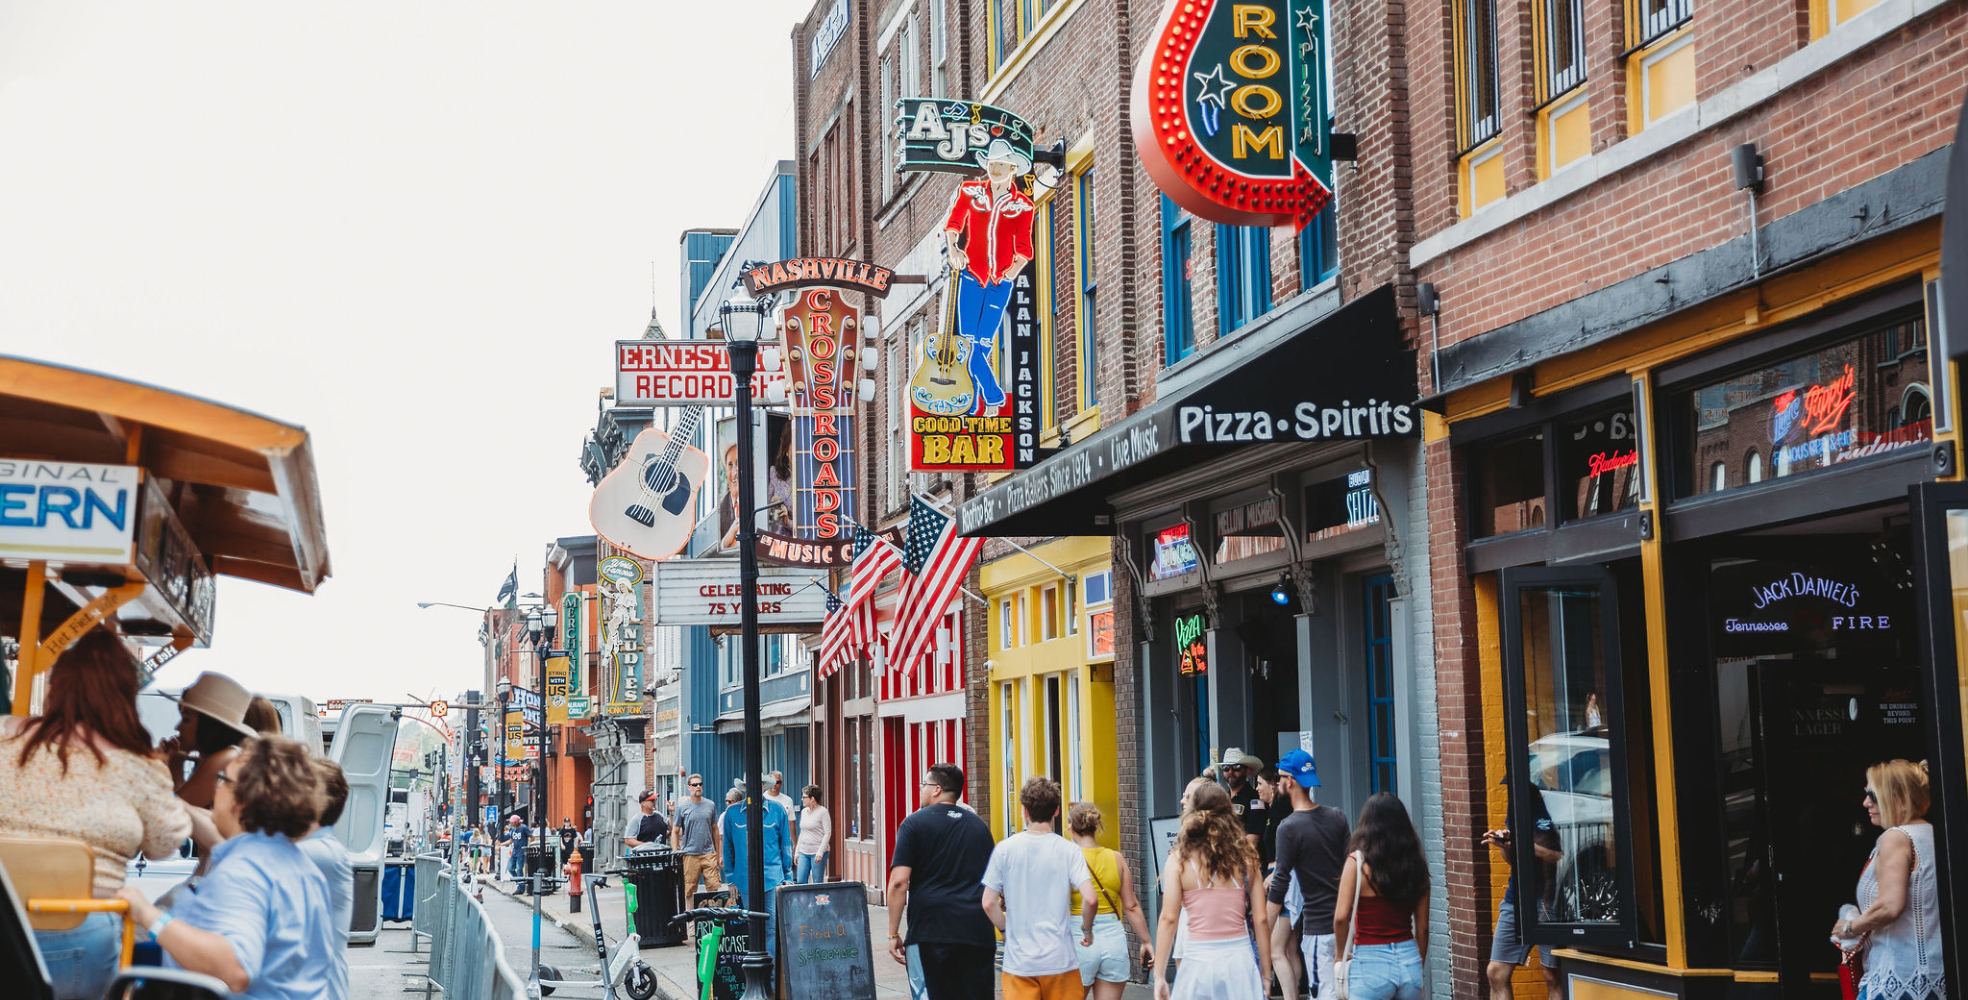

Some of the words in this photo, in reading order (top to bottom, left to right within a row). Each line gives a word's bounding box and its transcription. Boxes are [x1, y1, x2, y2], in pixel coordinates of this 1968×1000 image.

[1229, 3, 1285, 160] ROOM
[749, 257, 891, 291] NASHVILLE
[1016, 274, 1032, 338] ALAN
[621, 345, 729, 370] ERNEST
[636, 374, 733, 399] RECORD
[806, 287, 842, 540] CROSSROADS
[1017, 350, 1034, 463] JACKSON
[1179, 405, 1273, 444] Pizza
[1294, 398, 1413, 440] Spirits
[912, 415, 962, 434] GOOD
[963, 415, 1013, 434] TIME
[921, 434, 1006, 465] BAR
[961, 501, 984, 535] Rooftop
[983, 496, 995, 523] Bar
[1006, 482, 1025, 515] Pizza
[1024, 474, 1049, 507] Bakers
[1050, 464, 1070, 498] Since
[1071, 449, 1092, 487] 1974
[1110, 437, 1131, 471] Live
[1130, 418, 1160, 462] Music
[1216, 505, 1245, 537] MELLOW
[699, 582, 792, 598] CELEBATING
[1752, 578, 1793, 610] JACK
[1790, 571, 1861, 608] DANIEL'S
[708, 601, 727, 615] 75
[730, 600, 782, 615] YARS
[1724, 617, 1790, 633] Tennessee
[1831, 616, 1891, 630] FIRE
[623, 627, 639, 702] NUDIES
[548, 685, 567, 697] US
[507, 732, 522, 741] US
[798, 922, 832, 942] Find
